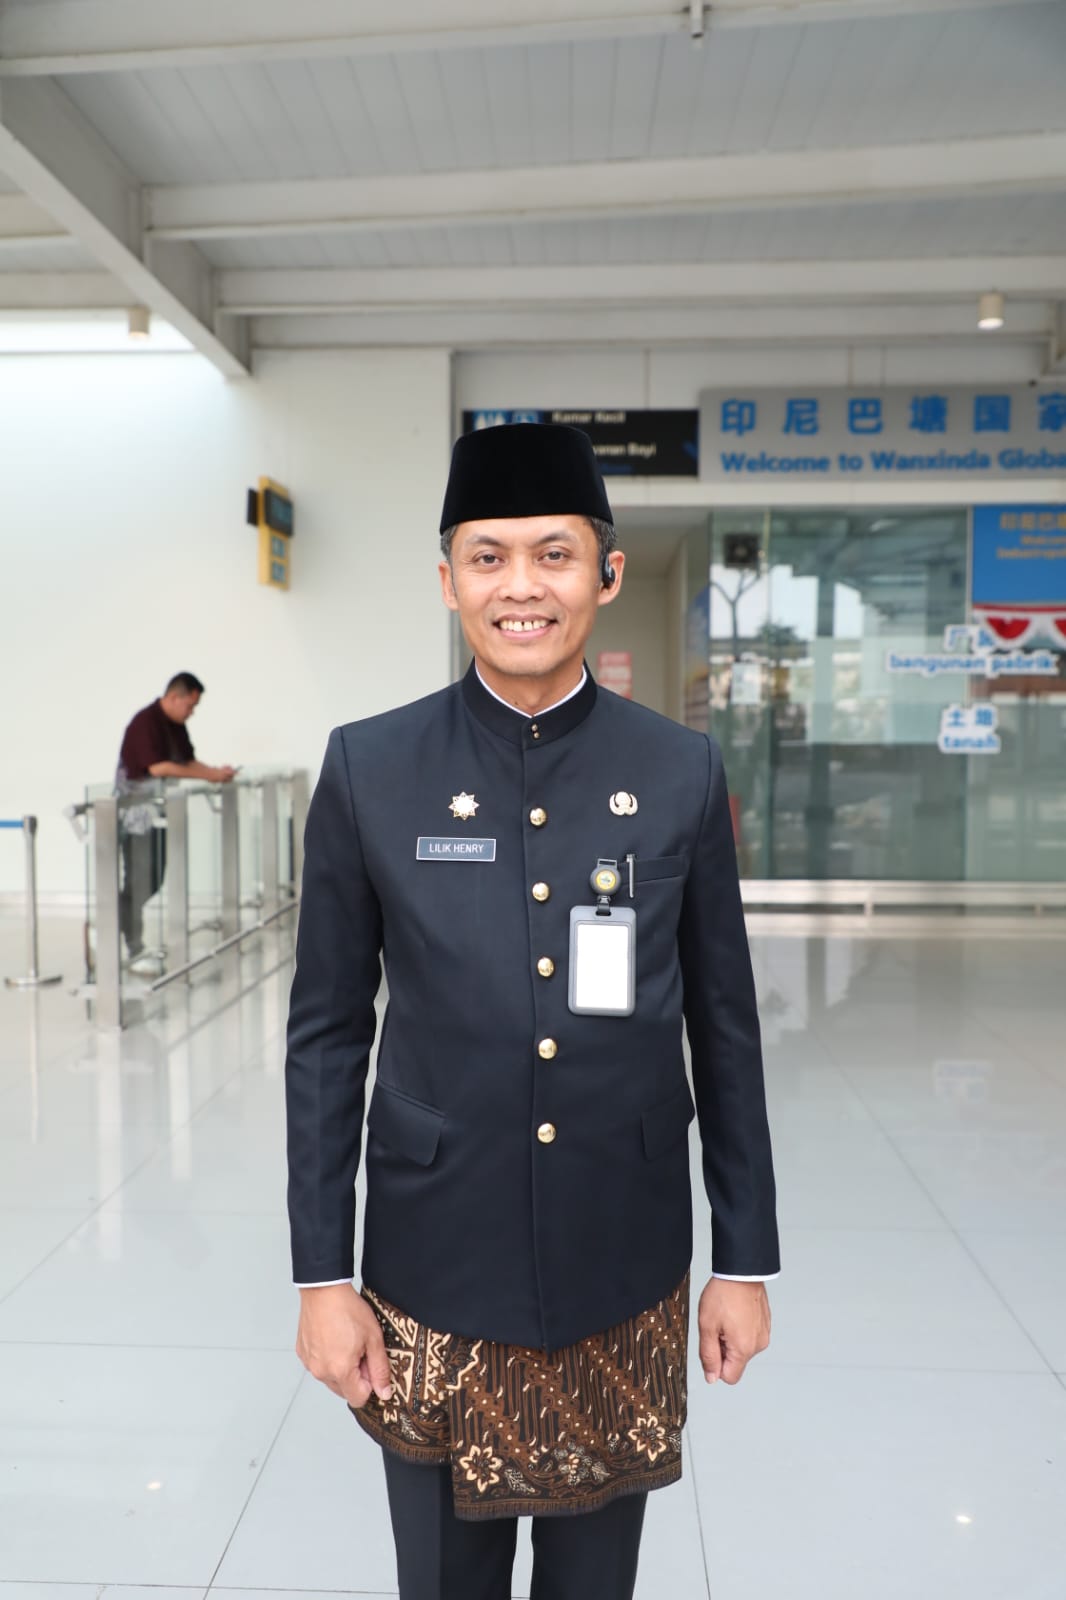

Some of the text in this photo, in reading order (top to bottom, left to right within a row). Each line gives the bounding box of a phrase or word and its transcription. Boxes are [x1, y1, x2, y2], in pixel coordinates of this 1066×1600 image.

[721, 452, 830, 472] Welcome
[838, 452, 863, 471] to
[870, 449, 991, 471] Wanxinda
[890, 654, 985, 673] bangunan
[943, 735, 998, 748] tanah
[429, 843, 484, 854] LILIK HENRY
